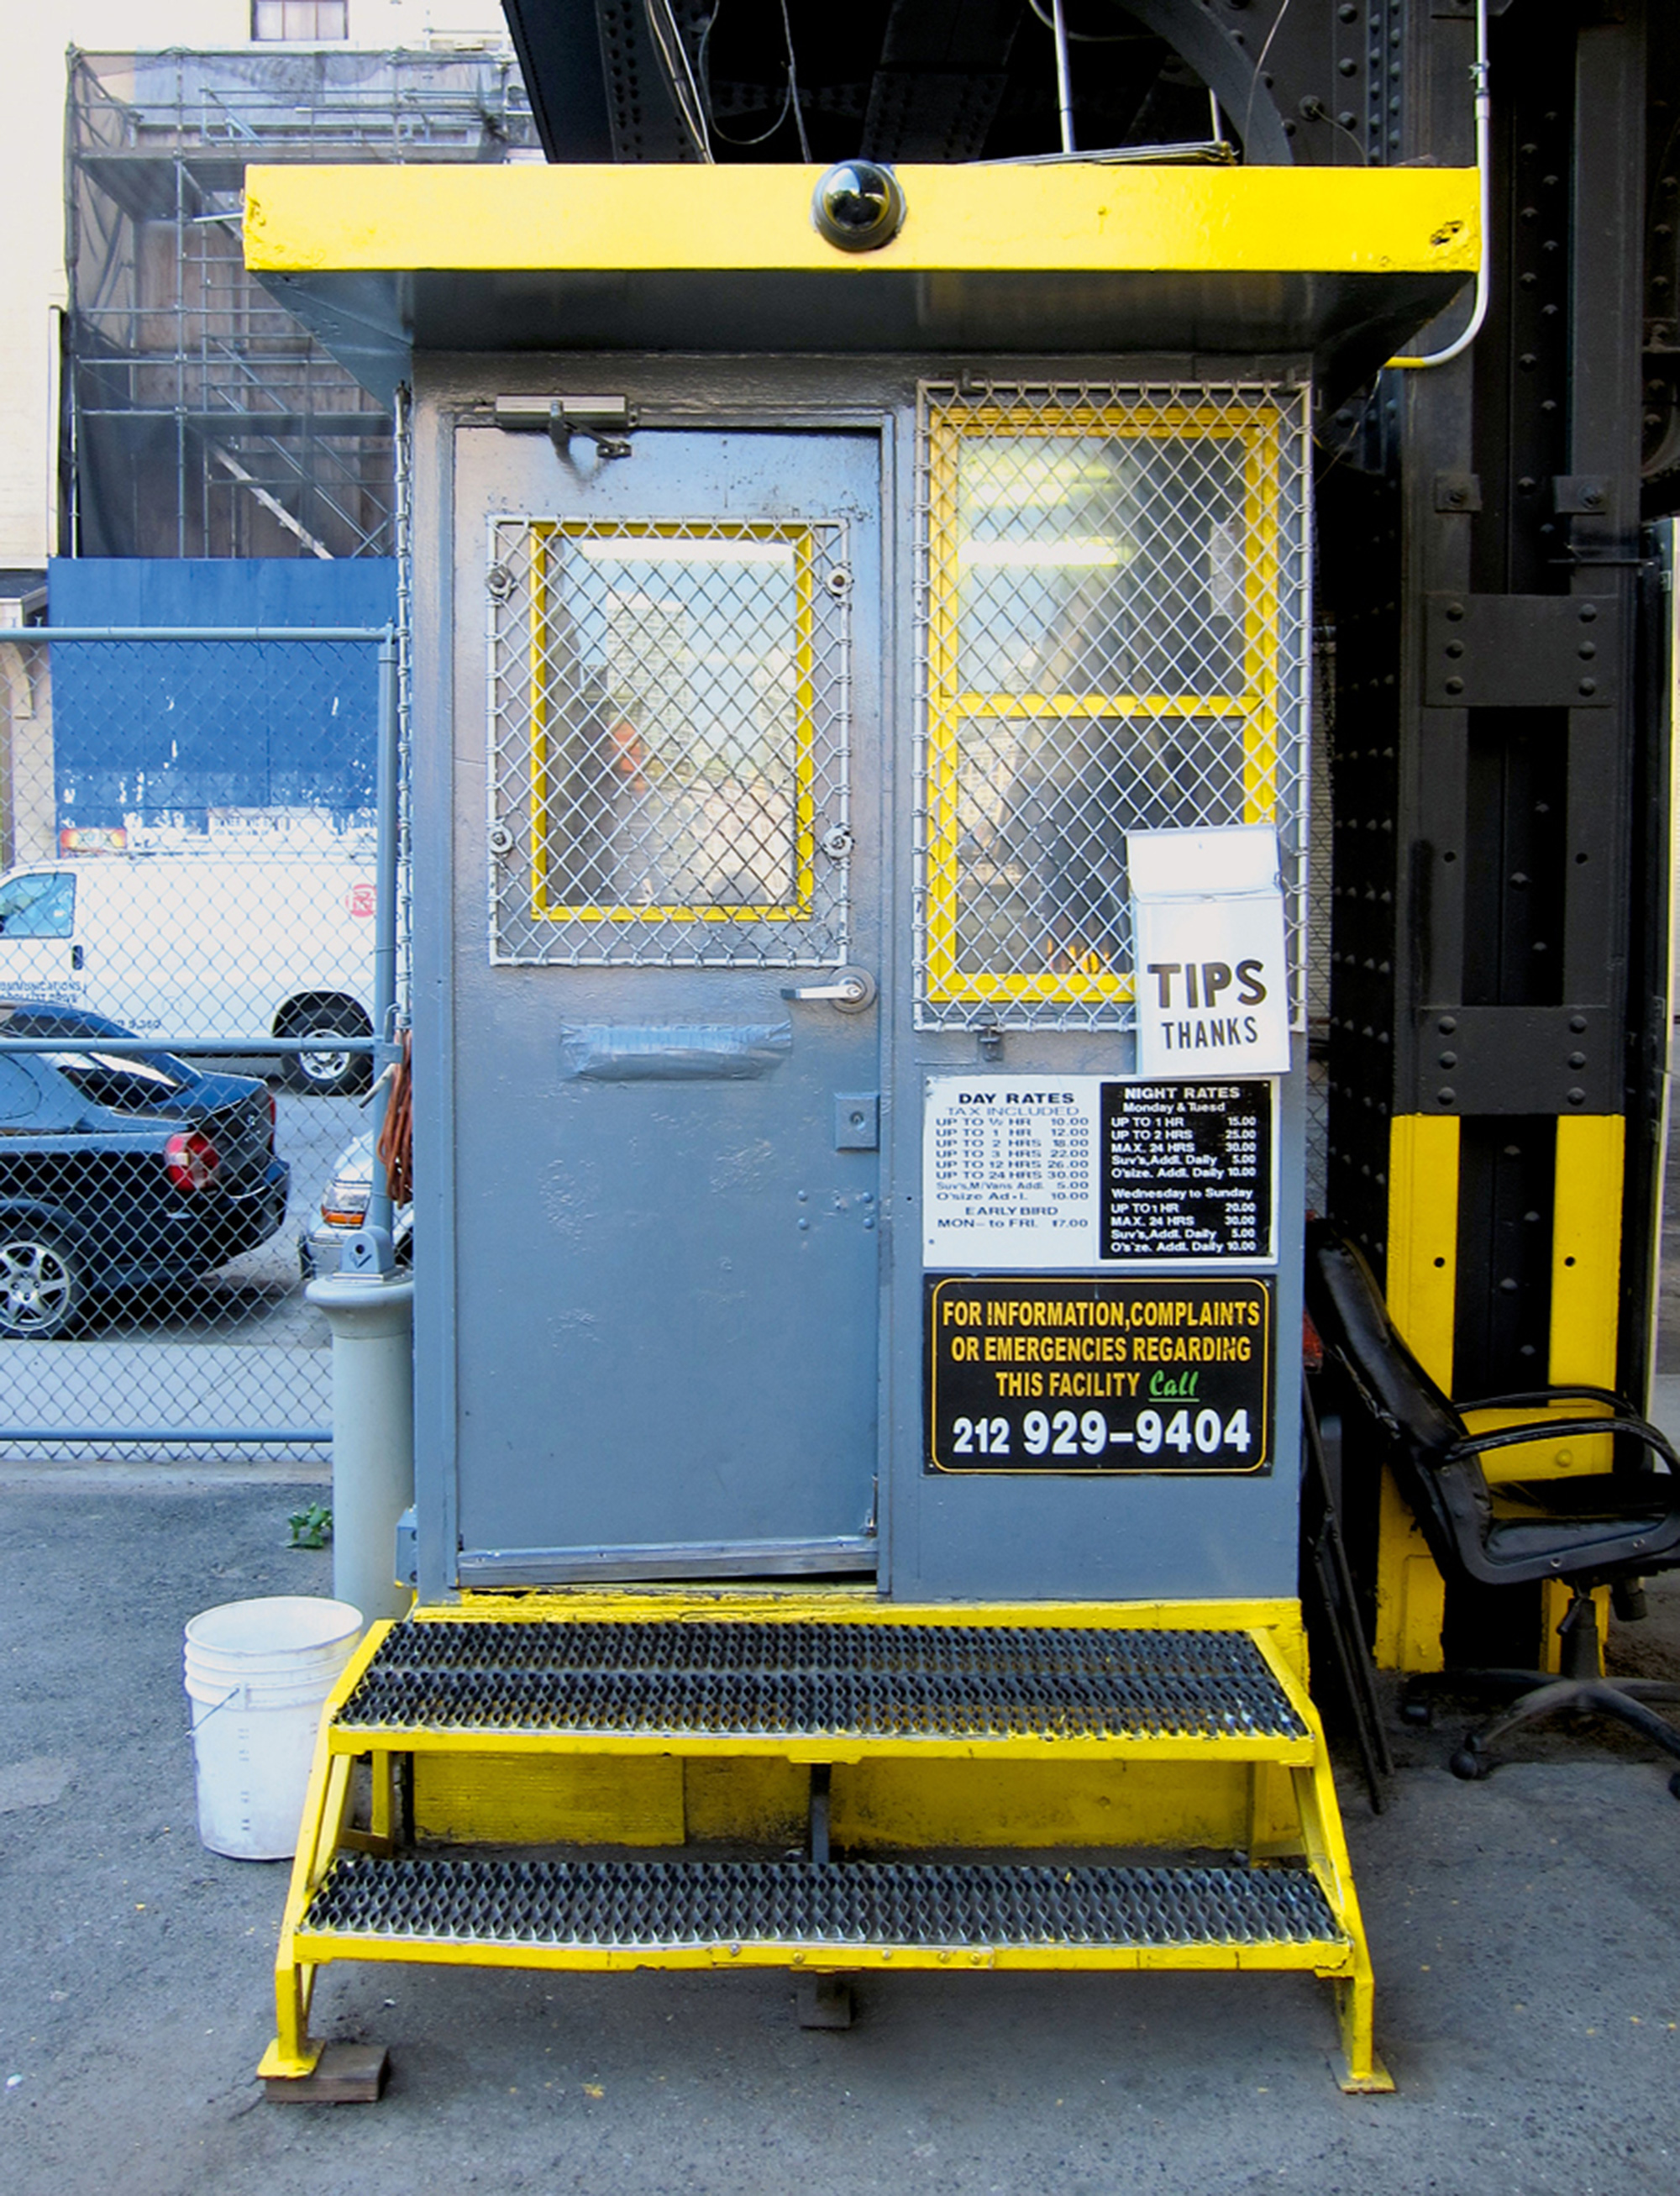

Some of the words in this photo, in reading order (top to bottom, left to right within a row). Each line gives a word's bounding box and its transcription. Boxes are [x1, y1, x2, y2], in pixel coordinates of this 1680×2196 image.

[1147, 959, 1267, 1008] TIPS
[1161, 1017, 1258, 1050] THANKS
[958, 1093, 996, 1104] DAY
[1006, 1093, 1075, 1104] RATES
[1124, 1088, 1178, 1099] NIGHT
[1184, 1087, 1241, 1098] RATES
[946, 1107, 980, 1116] TAX
[987, 1107, 1079, 1116] INCLUDED
[1123, 1102, 1174, 1114] Monday
[1177, 1103, 1186, 1111] &
[1110, 1117, 1129, 1127] UP
[1132, 1117, 1151, 1127] TO
[1156, 1117, 1161, 1127] 1
[1165, 1117, 1184, 1127] HR
[1227, 1116, 1257, 1126] 15.00
[1110, 1130, 1129, 1140] UP
[1132, 1130, 1151, 1140] TO
[1154, 1130, 1162, 1140] 2
[1165, 1130, 1193, 1140] HRS
[1110, 1143, 1146, 1153] MAX.
[1149, 1143, 1163, 1153] 24
[1168, 1143, 1195, 1153] HRS
[1186, 1155, 1217, 1166] Daily
[1231, 1155, 1257, 1164] 5.00
[1192, 1169, 1225, 1179] Daily
[1228, 1168, 1257, 1176] 10.00
[1051, 1192, 1089, 1200] 10.00
[1110, 1188, 1187, 1200] Wednesday
[1189, 1189, 1201, 1198] to
[1205, 1187, 1253, 1199] Sunday
[965, 1207, 1016, 1216] EARLY
[1020, 1207, 1058, 1216] BIRD
[1110, 1204, 1129, 1213] UP
[1132, 1204, 1151, 1213] TO
[1160, 1204, 1179, 1213] HR
[989, 1219, 1004, 1228] to
[1052, 1219, 1089, 1228] 17.00
[1110, 1216, 1146, 1226] MAX.
[1149, 1216, 1163, 1226] 24
[1167, 1216, 1195, 1226] HRS
[1224, 1216, 1256, 1225] 30.00
[1185, 1229, 1217, 1239] Daily
[1231, 1229, 1256, 1237] 5.00
[1192, 1242, 1224, 1253] Daily
[1227, 1242, 1257, 1250] 10.00
[942, 1302, 982, 1326] FOR
[951, 1337, 979, 1362] OR
[984, 1337, 1127, 1362] EMERGENCIES
[1132, 1337, 1252, 1362] REGARDING
[996, 1371, 1043, 1396] THIS
[1050, 1371, 1141, 1396] FACILITY
[1149, 1369, 1200, 1398] Call
[953, 1417, 1011, 1454] 212
